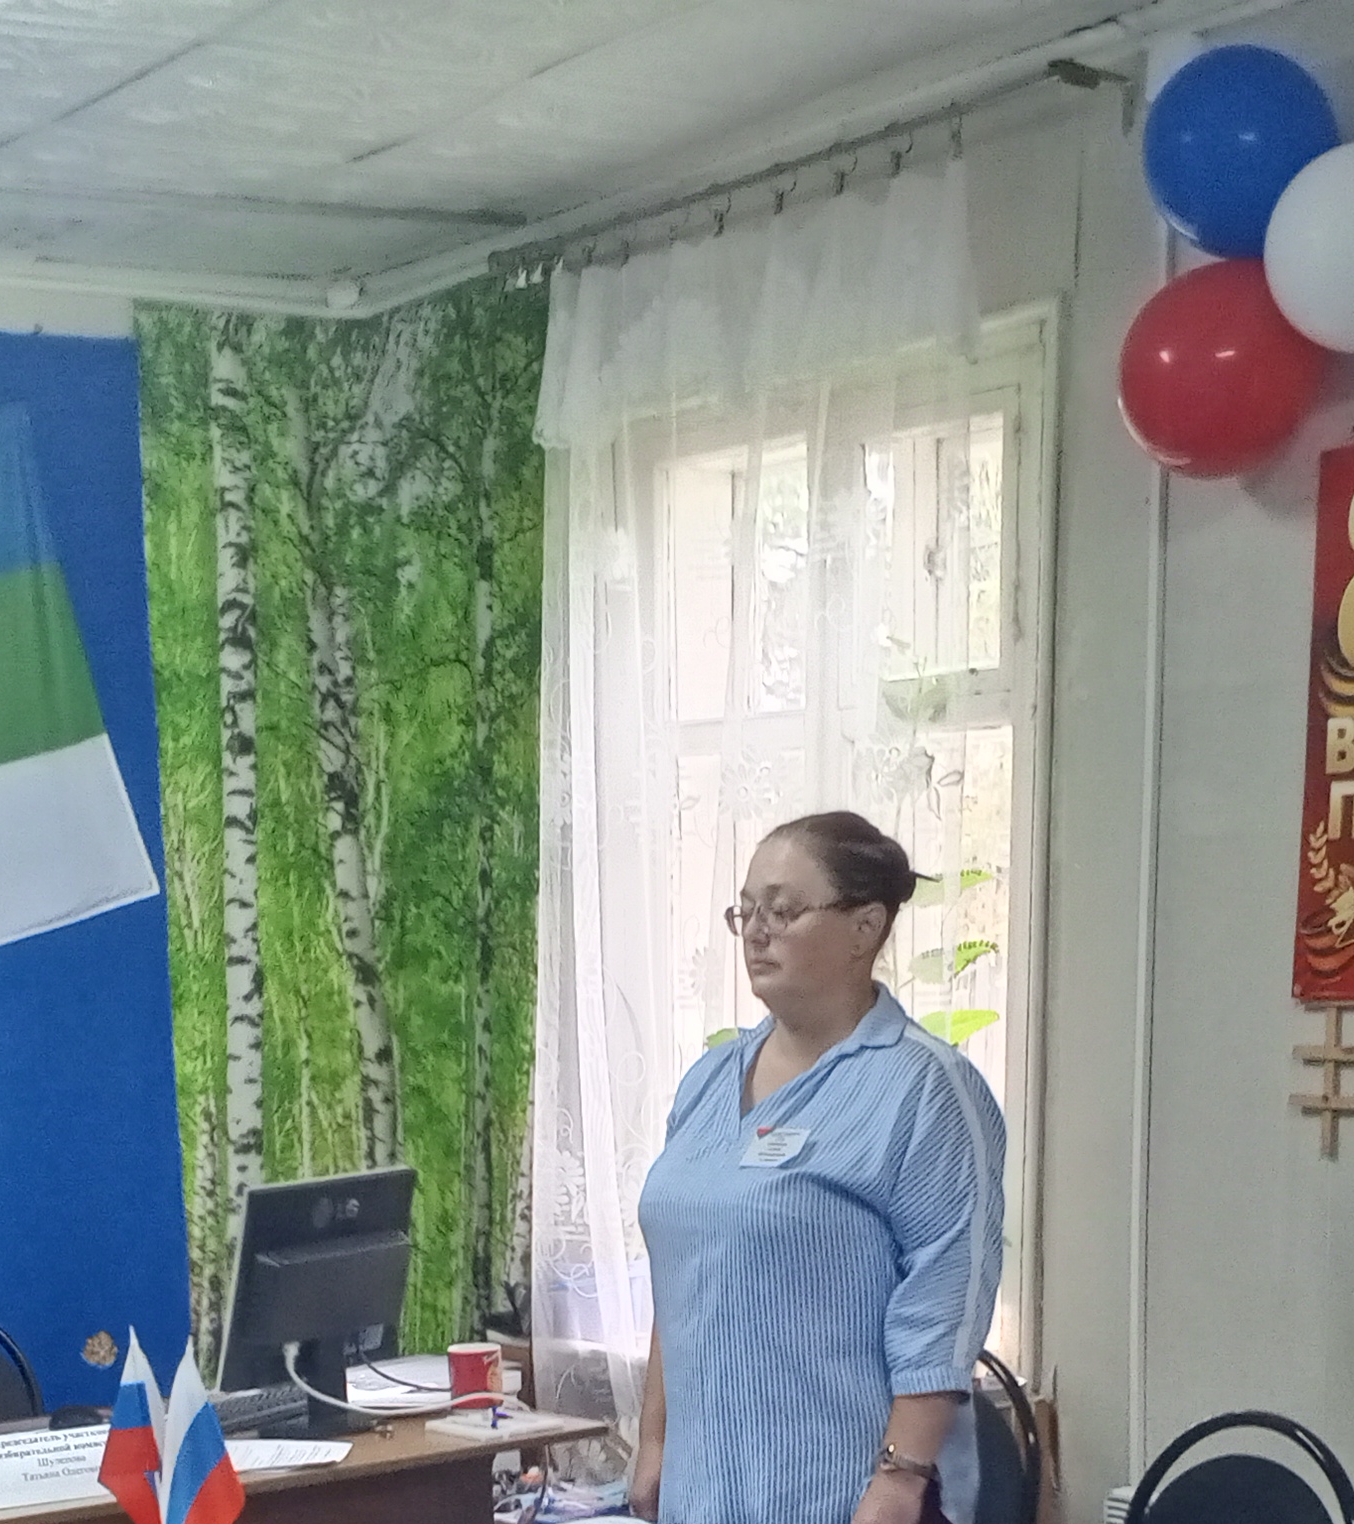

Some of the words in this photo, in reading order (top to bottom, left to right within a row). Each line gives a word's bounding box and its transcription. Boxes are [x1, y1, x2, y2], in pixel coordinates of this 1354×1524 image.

[63, 1429, 109, 1442] участков
[21, 1470, 61, 1482] Татьяна
[61, 1466, 101, 1478] Олегов
